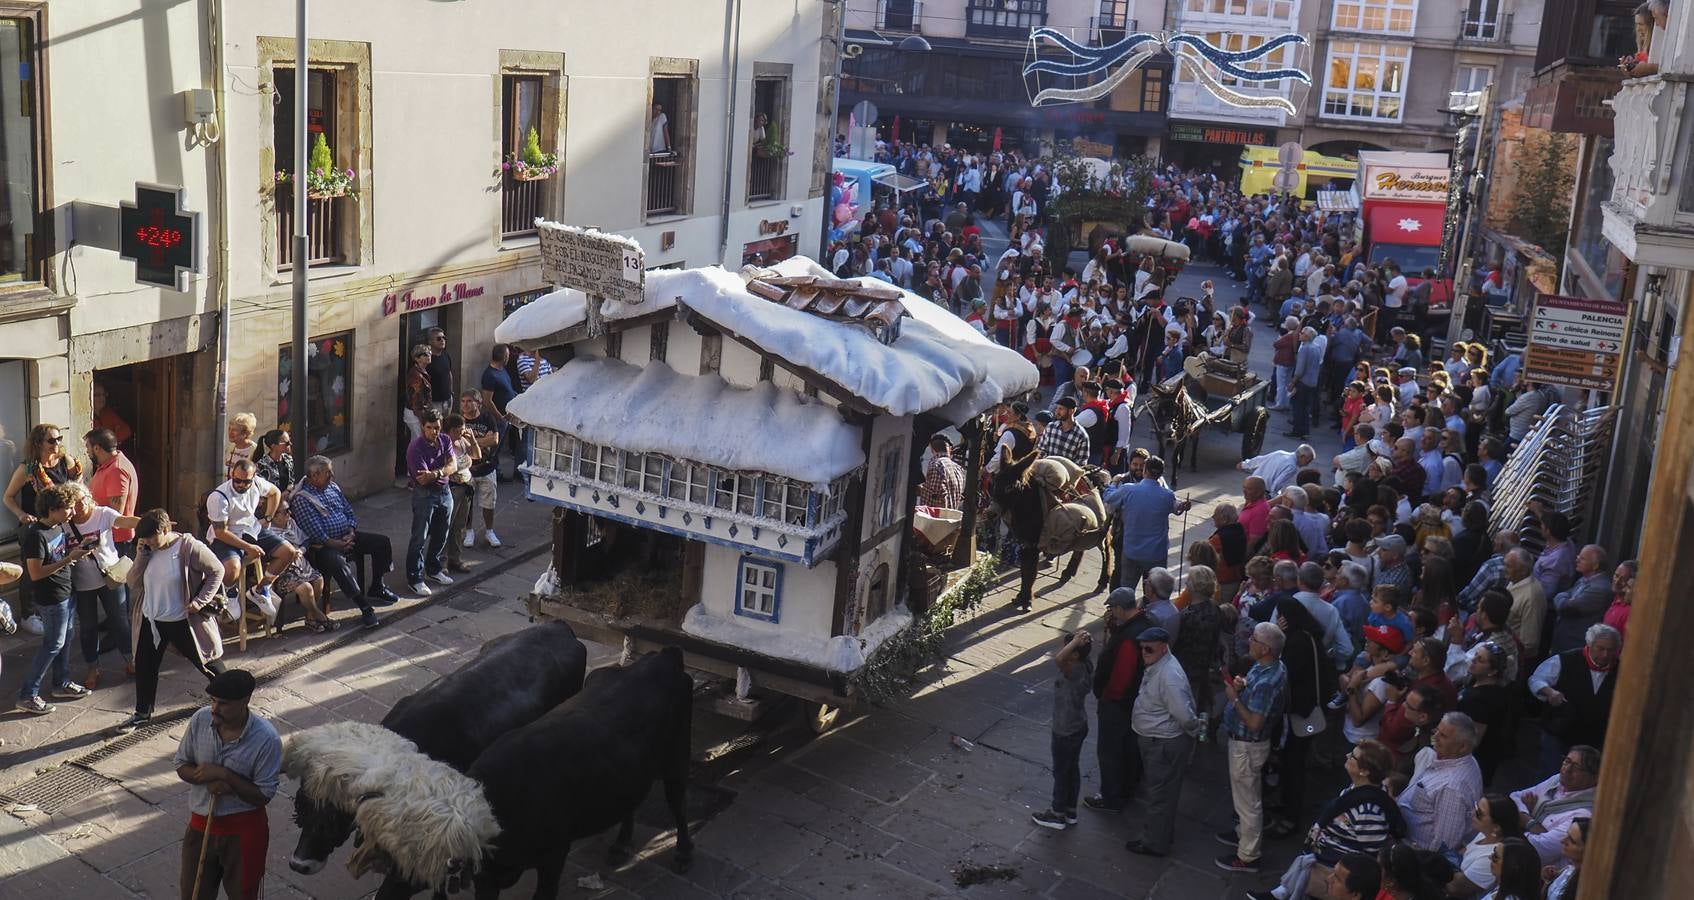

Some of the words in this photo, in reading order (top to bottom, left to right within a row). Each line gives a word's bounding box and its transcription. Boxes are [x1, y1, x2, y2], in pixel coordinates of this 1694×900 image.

[624, 255, 639, 270] 13
[383, 293, 396, 316] El
[401, 290, 436, 311] Tesoro
[440, 284, 452, 304] de
[1582, 314, 1622, 325] PALENCIA
[1591, 328, 1621, 338] Reinosa
[1534, 335, 1556, 343] centro
[1570, 338, 1590, 346] salud
